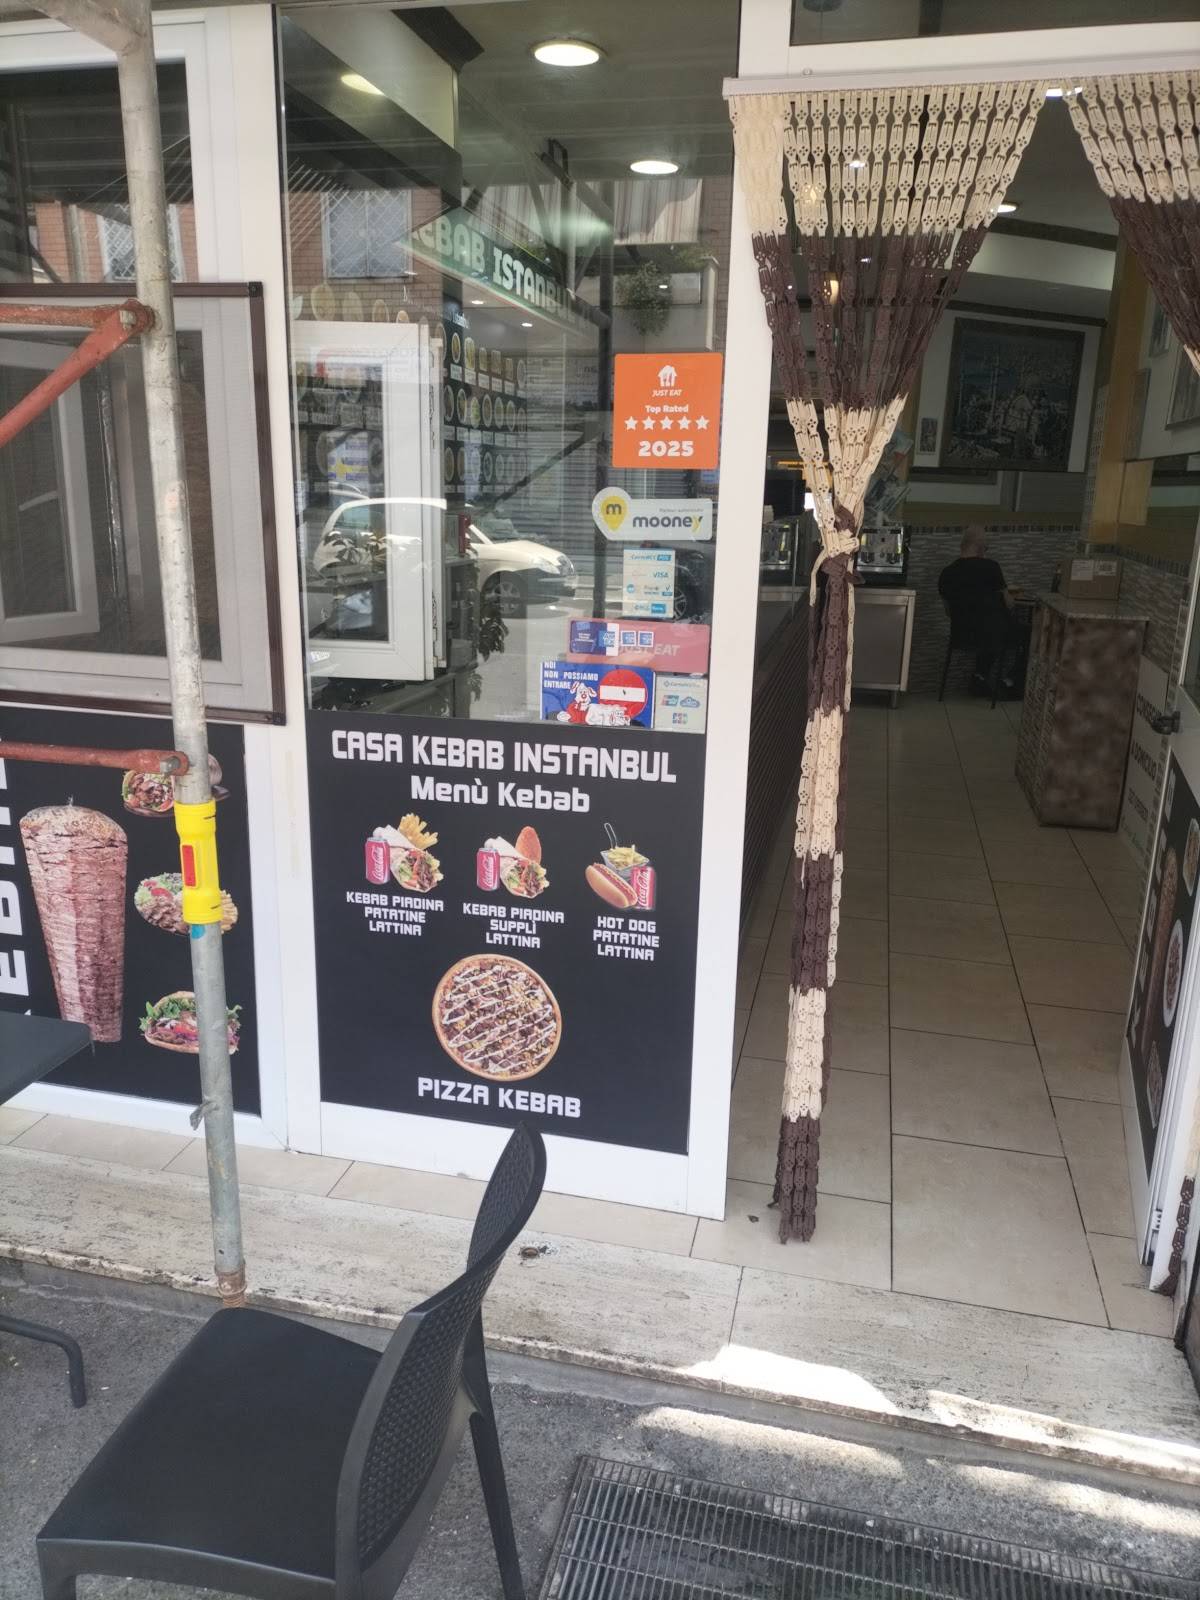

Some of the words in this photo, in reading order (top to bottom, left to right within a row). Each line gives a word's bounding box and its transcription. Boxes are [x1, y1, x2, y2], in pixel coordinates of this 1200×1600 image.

[412, 215, 485, 273] EBAB
[652, 389, 667, 397] JUST
[669, 389, 682, 397] EAT
[645, 405, 661, 414] Top
[663, 404, 689, 413] Rated
[638, 440, 694, 457] 2025
[606, 503, 622, 515] m
[633, 515, 703, 533] mooney
[654, 643, 680, 656] EAT
[544, 661, 557, 669] NOI
[544, 670, 559, 679] NON
[563, 671, 599, 682] POSSIAMO
[543, 680, 572, 690] ENTRARE
[331, 730, 403, 763] CASA
[412, 735, 505, 771] KEBAB
[514, 742, 677, 783] INSTANBUL
[411, 775, 488, 805] Menù
[498, 782, 590, 813] Kebab
[346, 891, 388, 906] KEBAB
[391, 895, 444, 912] PIADINA
[364, 906, 426, 923] PATATINE
[462, 902, 507, 918] KEBAB
[510, 907, 565, 924] PIADINA
[369, 919, 422, 936] LATTINA
[490, 919, 537, 935] SUPPLÌ
[597, 915, 624, 931] HOT
[628, 919, 656, 934] DOG
[486, 931, 541, 949] LATTINA
[593, 929, 659, 949] PATATINE
[597, 943, 655, 962] LATTINA
[417, 1076, 490, 1106] PIZZA
[498, 1087, 581, 1118] KEBAB
